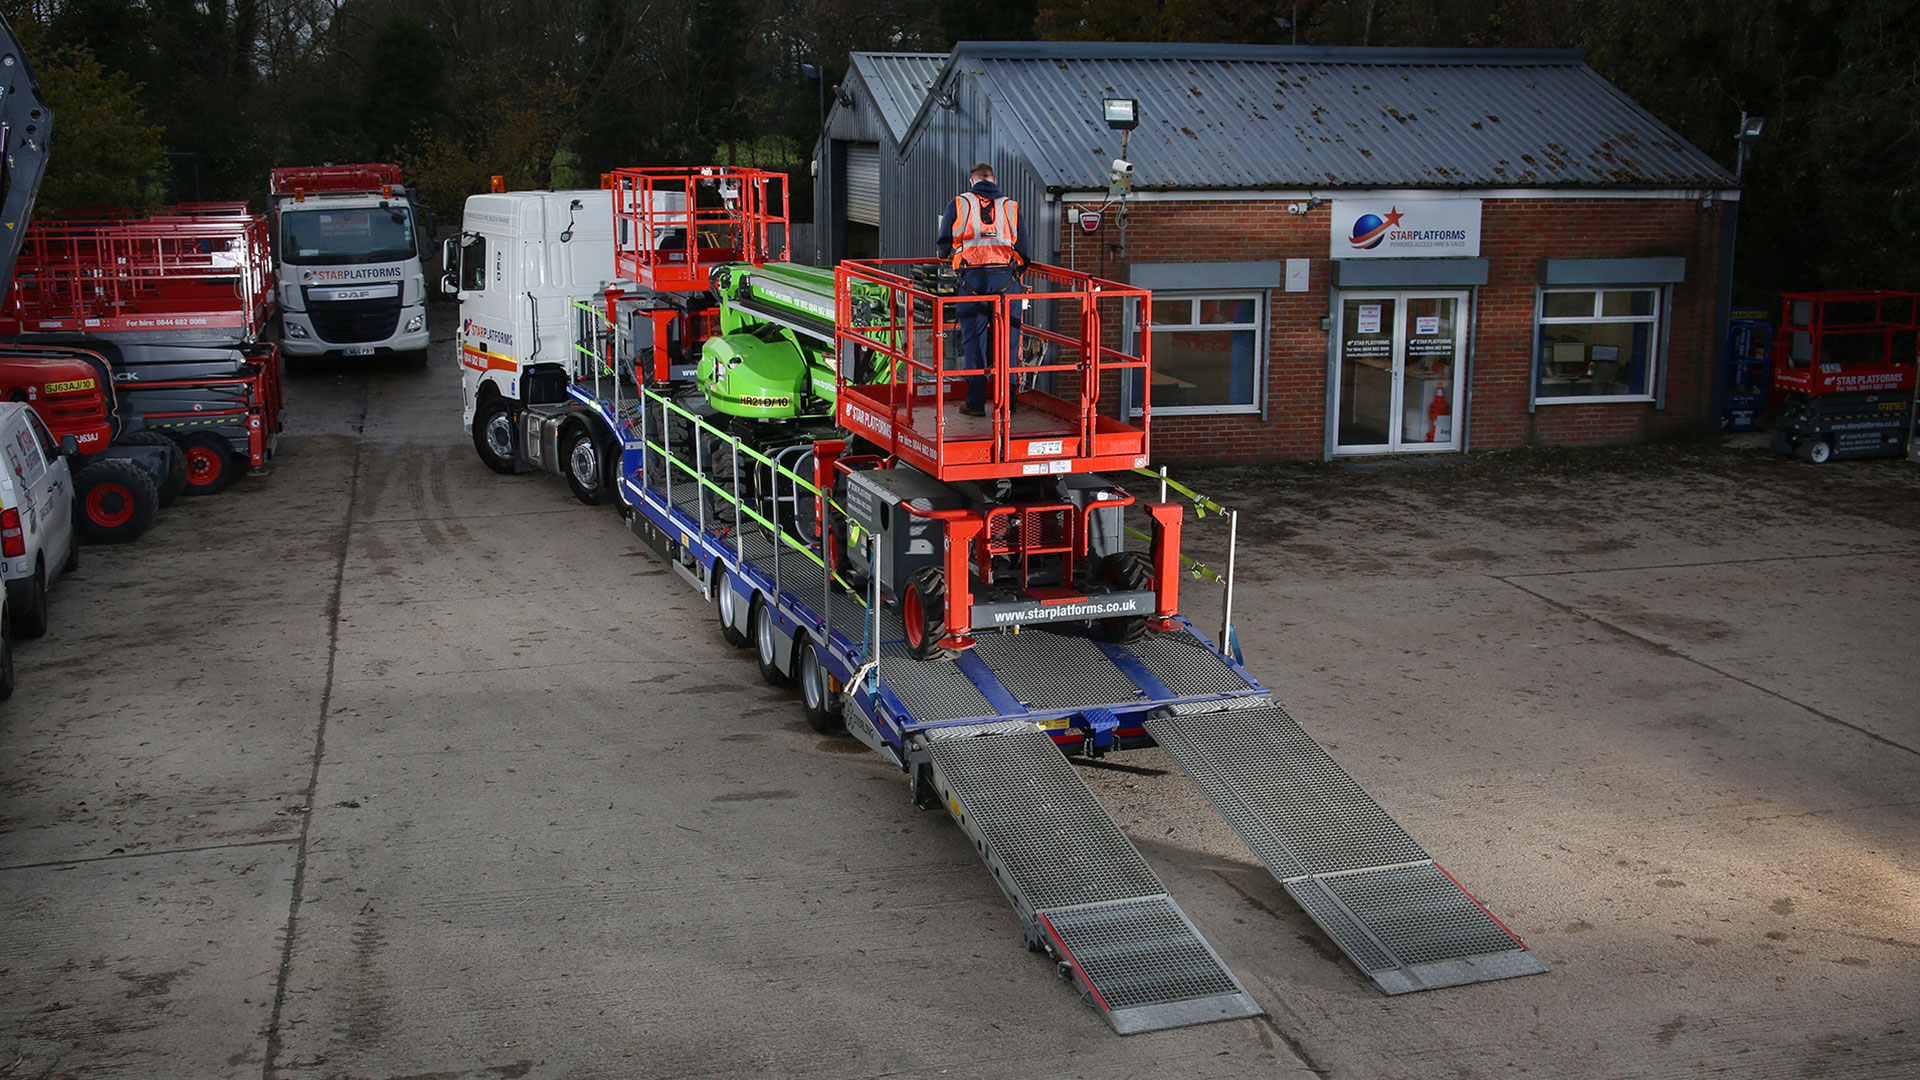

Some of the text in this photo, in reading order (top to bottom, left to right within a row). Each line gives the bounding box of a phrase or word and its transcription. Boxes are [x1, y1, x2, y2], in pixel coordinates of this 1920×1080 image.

[1390, 231, 1466, 241] STARPLATFORMS
[319, 268, 401, 281] STARPLATFORMS
[338, 291, 370, 299] DAF
[472, 325, 513, 346] STARPLATFORMS
[1836, 373, 1903, 386] STAR PLATFORMS
[45, 381, 91, 393] SJ63AJ/10
[994, 599, 1137, 622] www.starplatforms.co.uk
